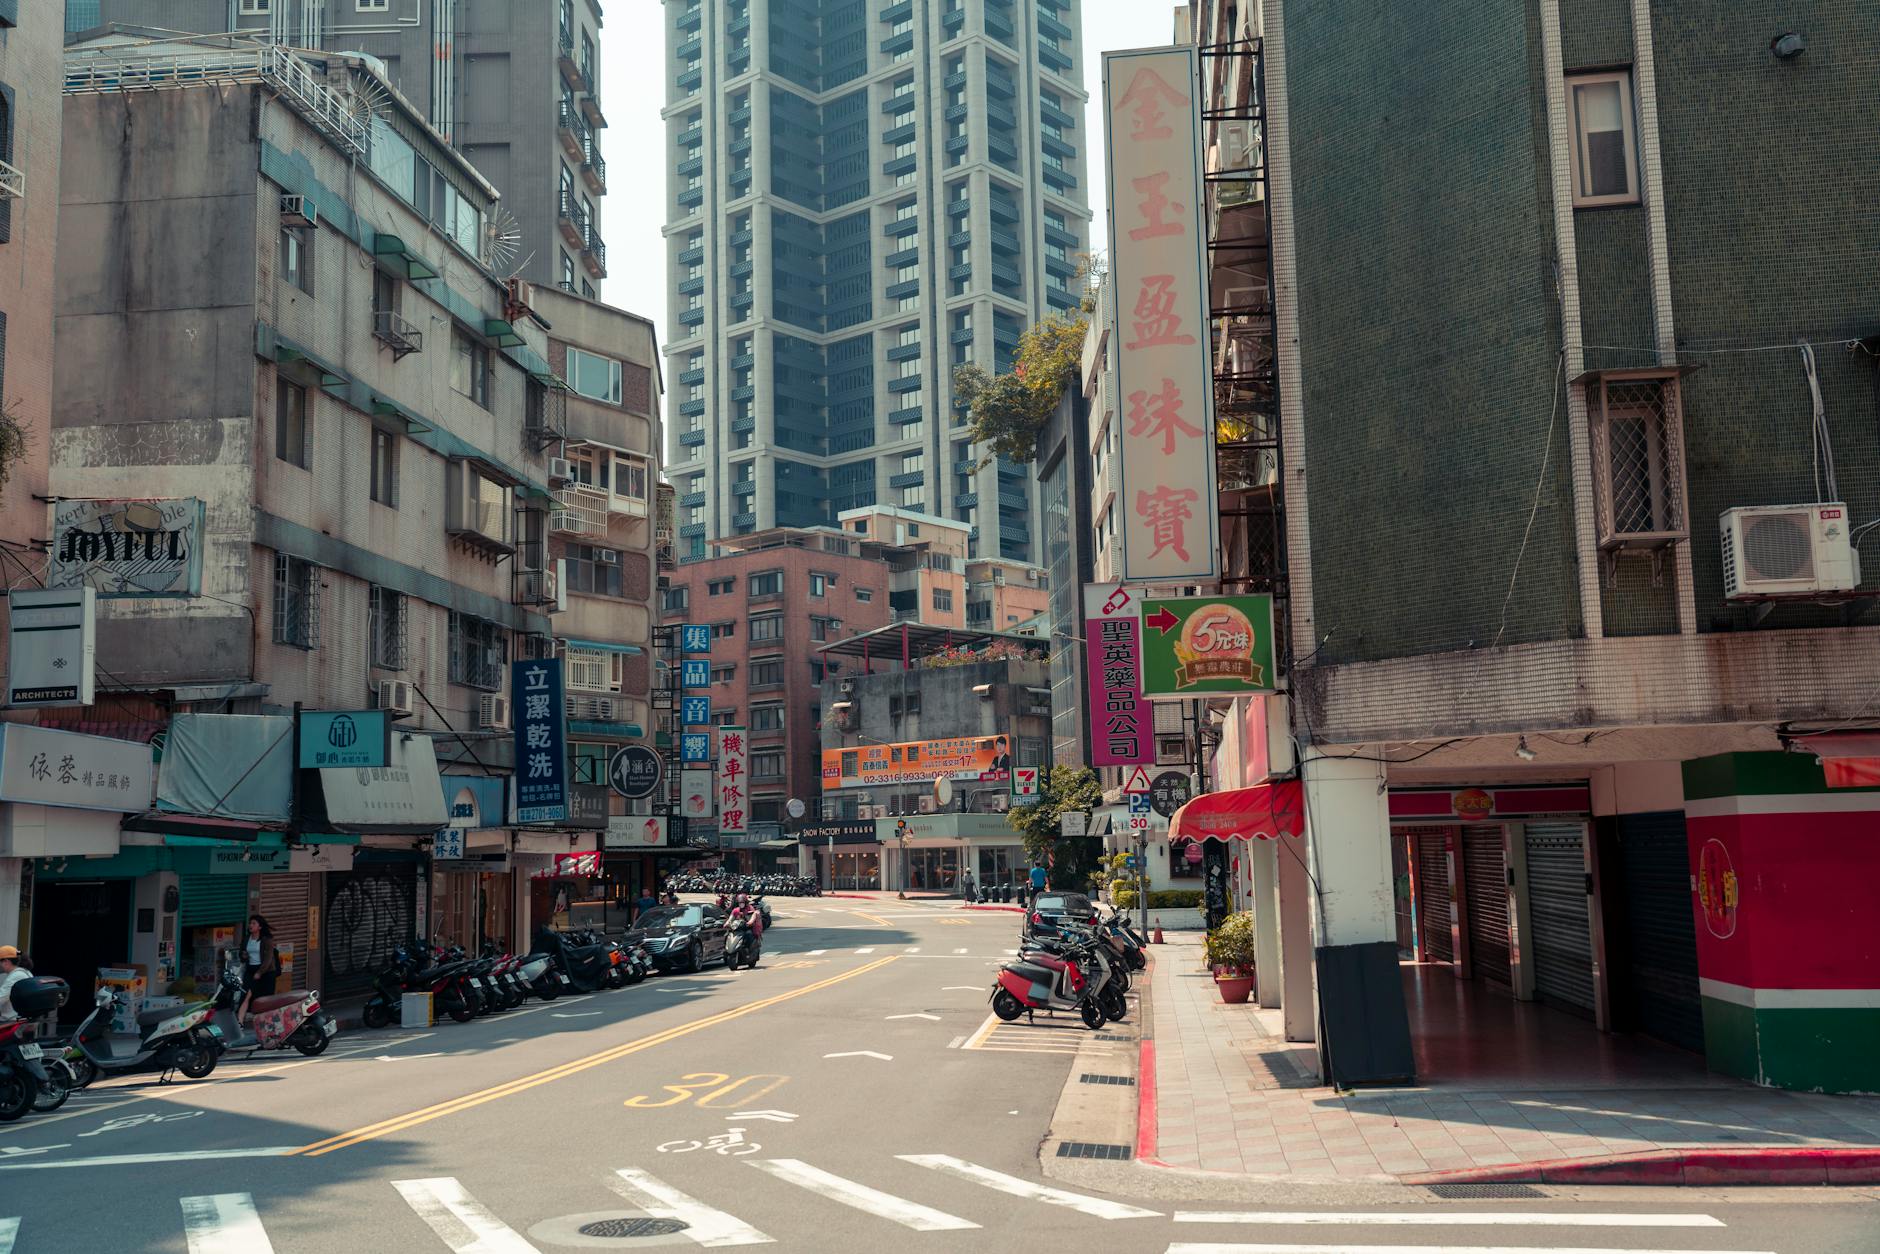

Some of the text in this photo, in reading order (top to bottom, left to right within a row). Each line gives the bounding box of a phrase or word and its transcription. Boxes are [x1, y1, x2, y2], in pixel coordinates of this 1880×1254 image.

[1113, 65, 1205, 563] 金玉盈珠寶
[60, 531, 186, 562] JOYFUL
[15, 690, 75, 700] ARCHITECTS
[685, 628, 706, 759] 集品音響
[1101, 621, 1139, 759] 聖英藥品公司
[524, 665, 553, 779] 立潔乾洗
[30, 752, 78, 784] 依蓉
[721, 733, 744, 831] 機車修理
[1130, 793, 1142, 812] P
[1153, 788, 1187, 801] 有機
[435, 831, 460, 842] 服裝
[803, 828, 818, 837] SNOW
[818, 827, 841, 836] FACTORY
[1130, 818, 1147, 829] 30
[435, 845, 460, 857] 修改
[623, 1072, 792, 1109] 30
